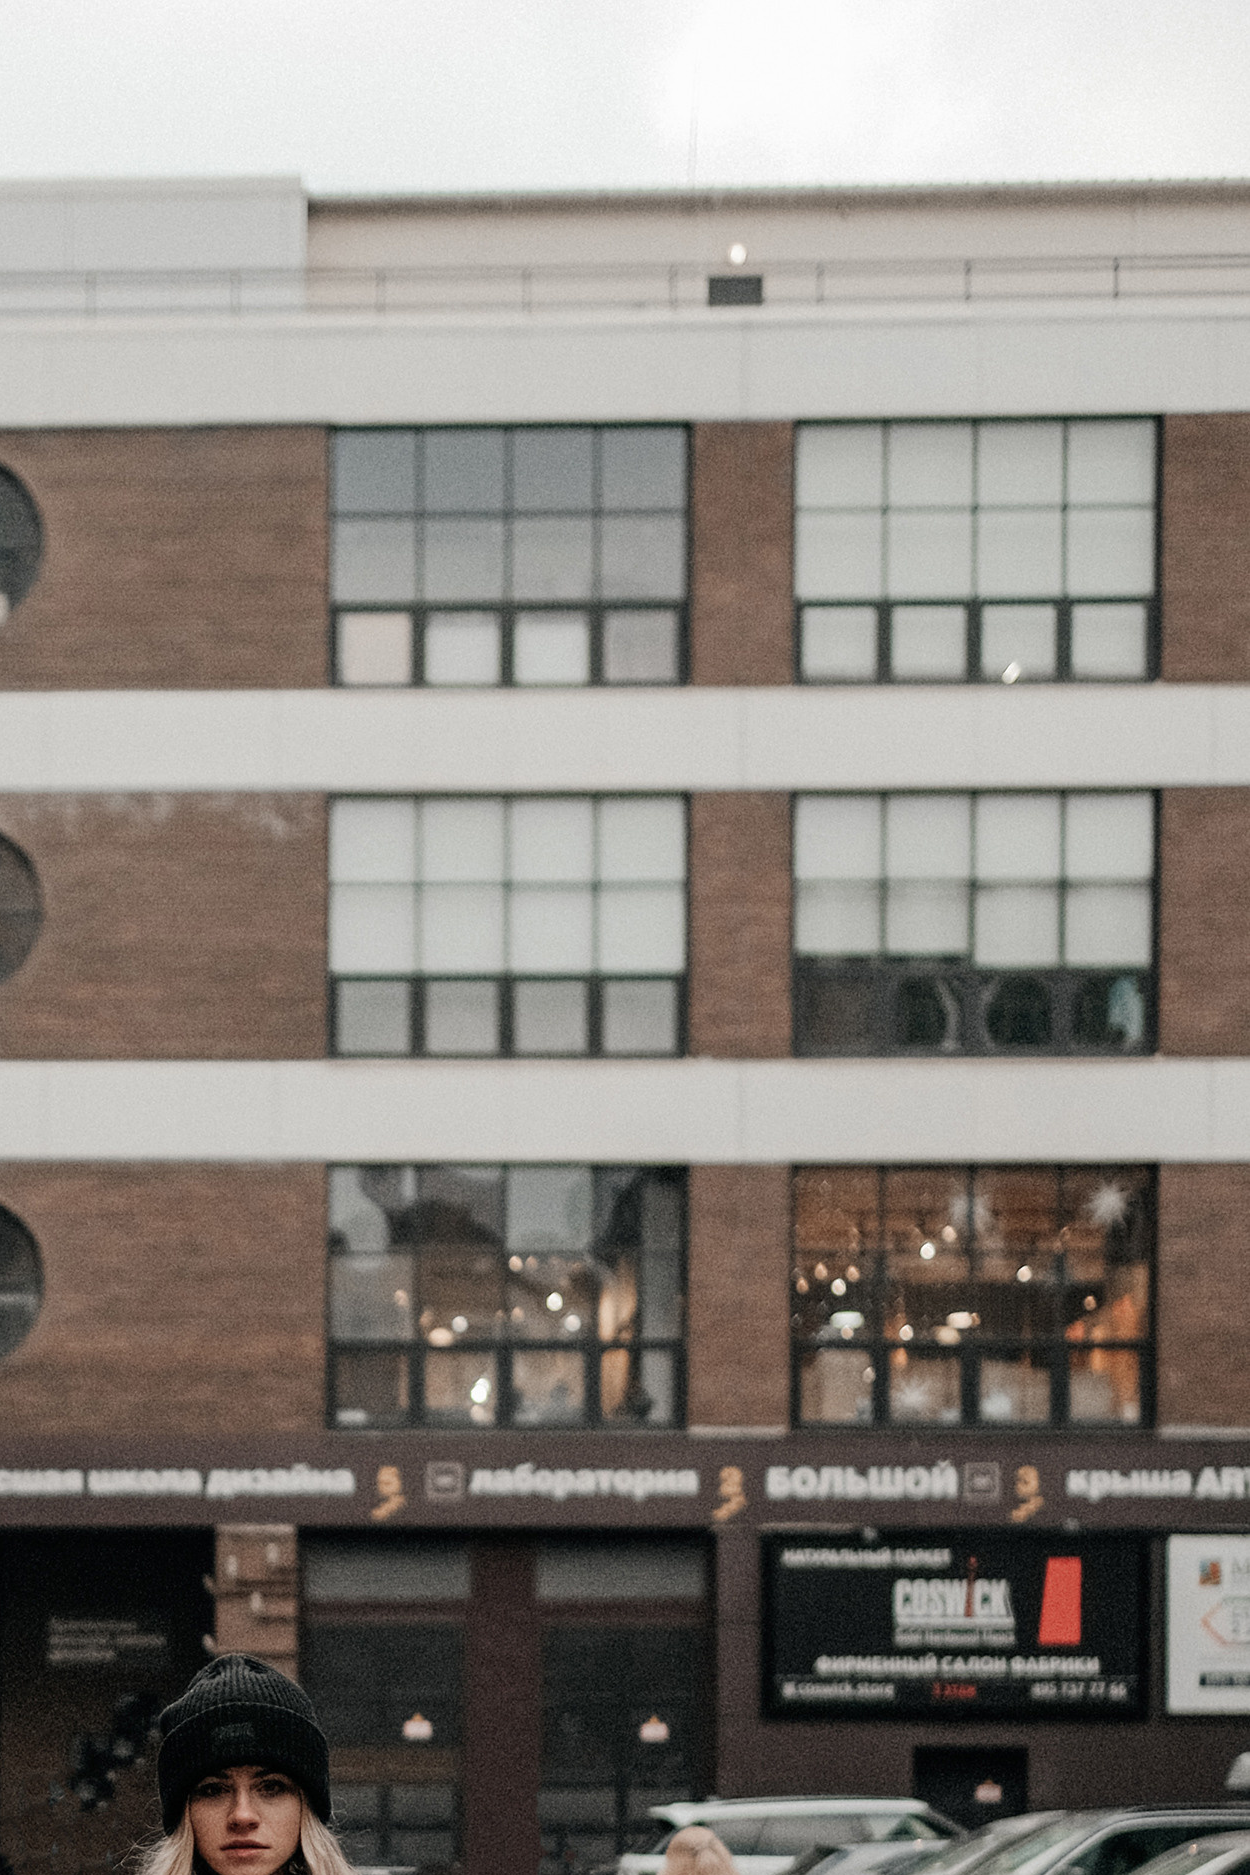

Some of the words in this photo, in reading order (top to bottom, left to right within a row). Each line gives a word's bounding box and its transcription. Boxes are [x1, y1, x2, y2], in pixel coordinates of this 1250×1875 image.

[206, 1463, 356, 1499] дизайна
[469, 1463, 699, 1501] лаборатория
[765, 1460, 959, 1500] БОЛЬШОЙ
[1066, 1469, 1192, 1501] крыша
[893, 1577, 1012, 1617] COSWICK
[814, 1652, 938, 1679] ФИРМЕННЫЙ
[940, 1655, 1007, 1679] САЛОН
[1010, 1655, 1101, 1679] ФАБРИКИ
